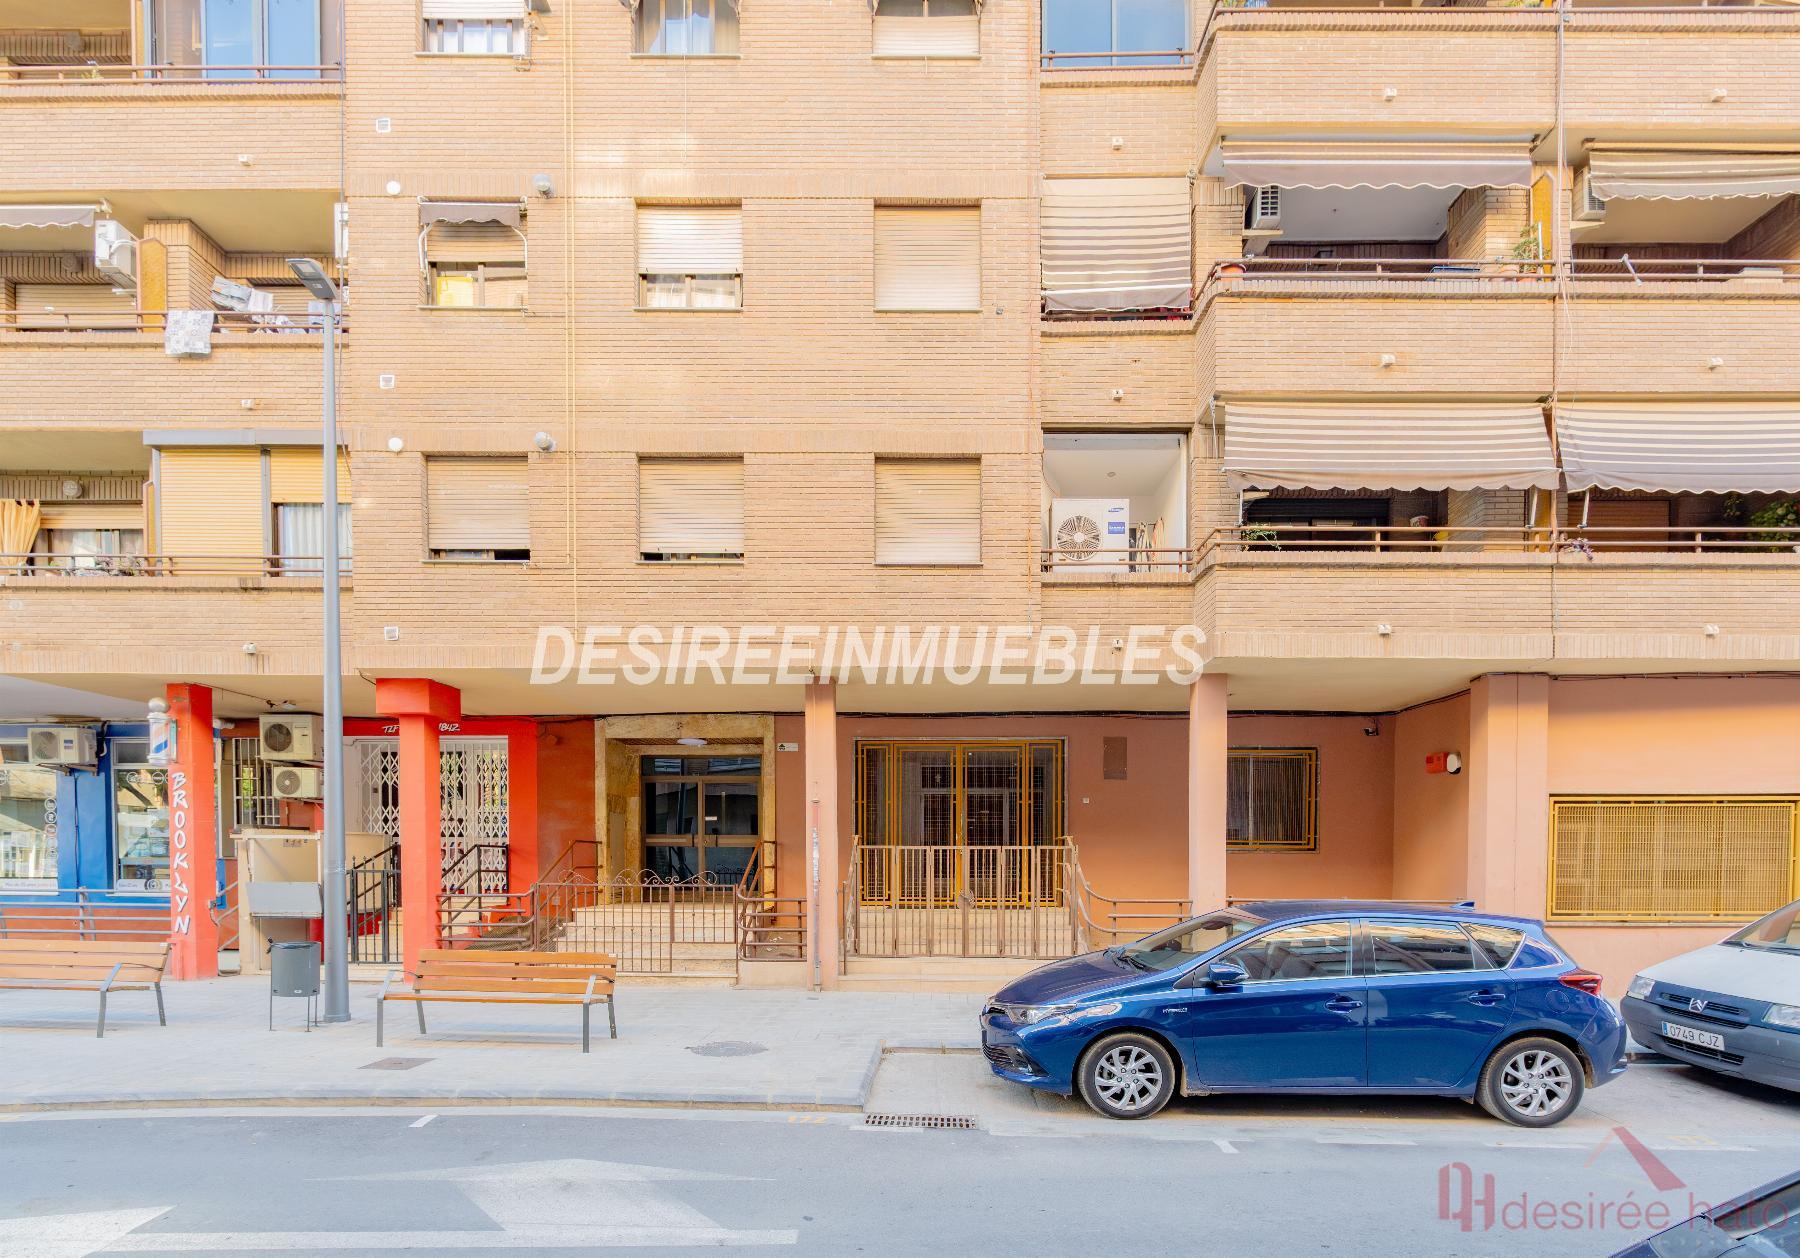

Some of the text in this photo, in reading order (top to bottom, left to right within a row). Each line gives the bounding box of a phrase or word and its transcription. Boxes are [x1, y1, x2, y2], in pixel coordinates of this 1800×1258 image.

[171, 772, 190, 936] BROOKLYN
[1669, 1025, 1720, 1048] 0749 CJZ
